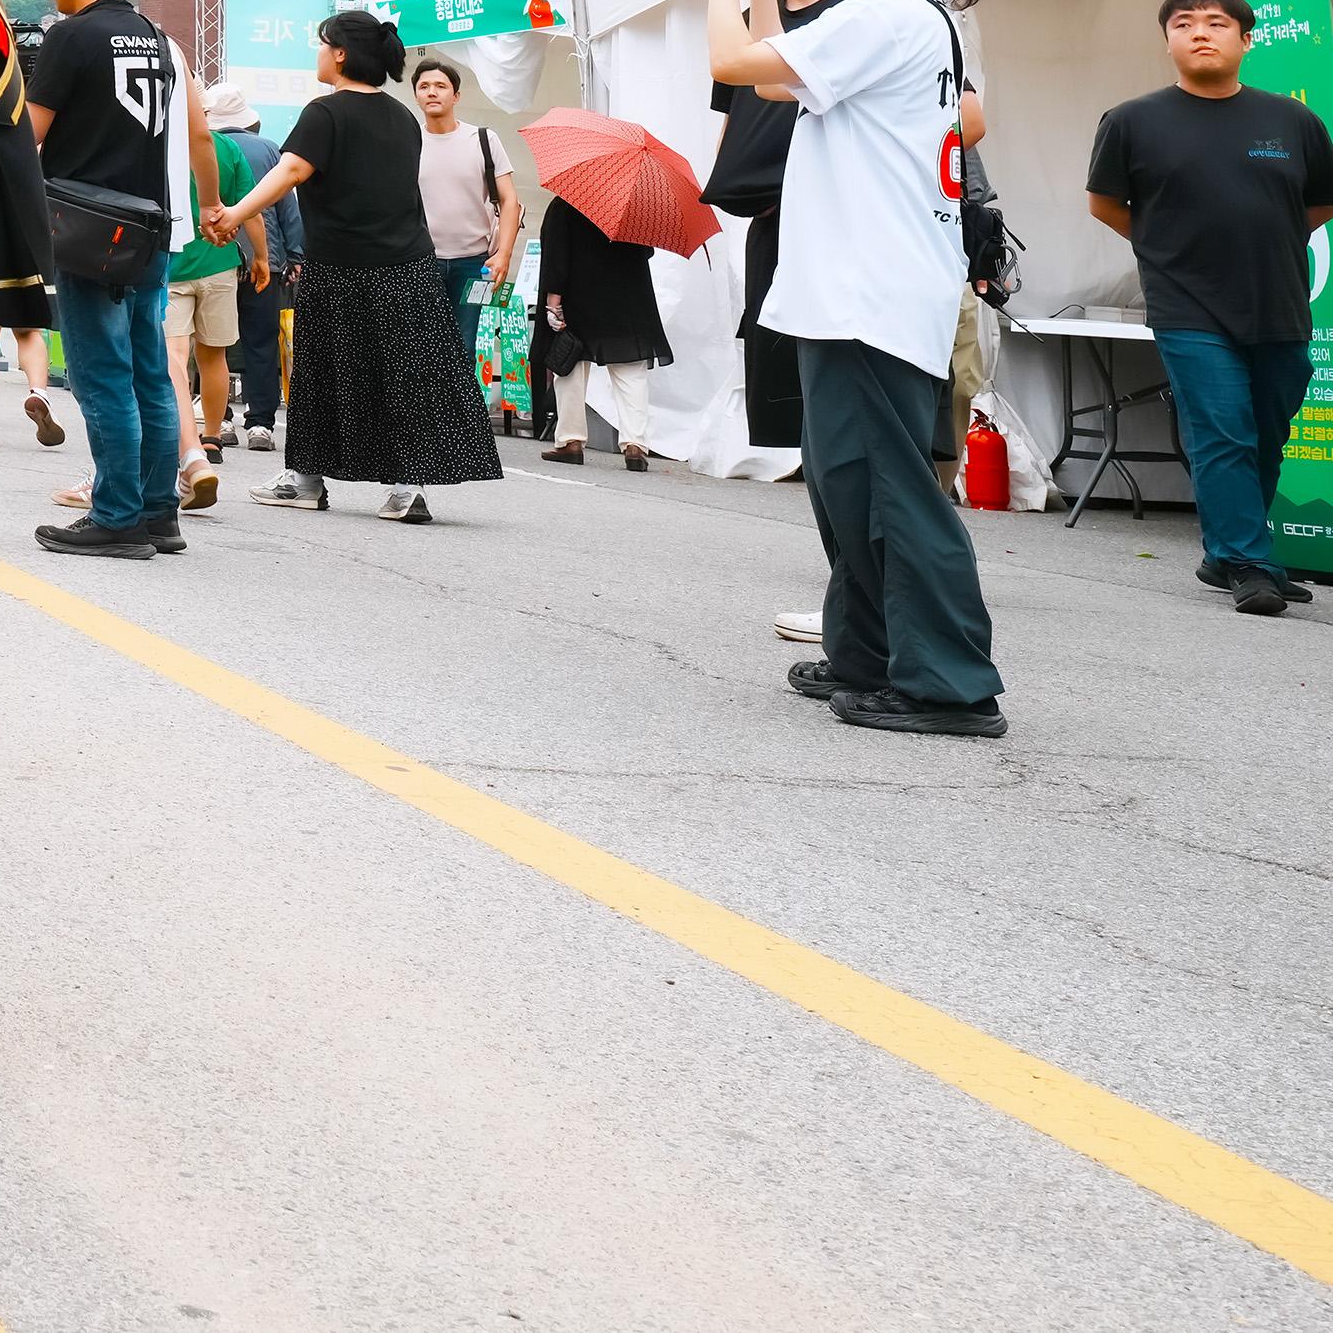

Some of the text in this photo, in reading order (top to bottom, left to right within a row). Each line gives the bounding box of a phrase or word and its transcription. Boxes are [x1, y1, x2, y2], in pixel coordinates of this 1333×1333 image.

[937, 68, 956, 110] T
[500, 309, 529, 336] 퇴촌토마
[1311, 347, 1330, 362] 있어
[1283, 523, 1323, 537] GCCF
